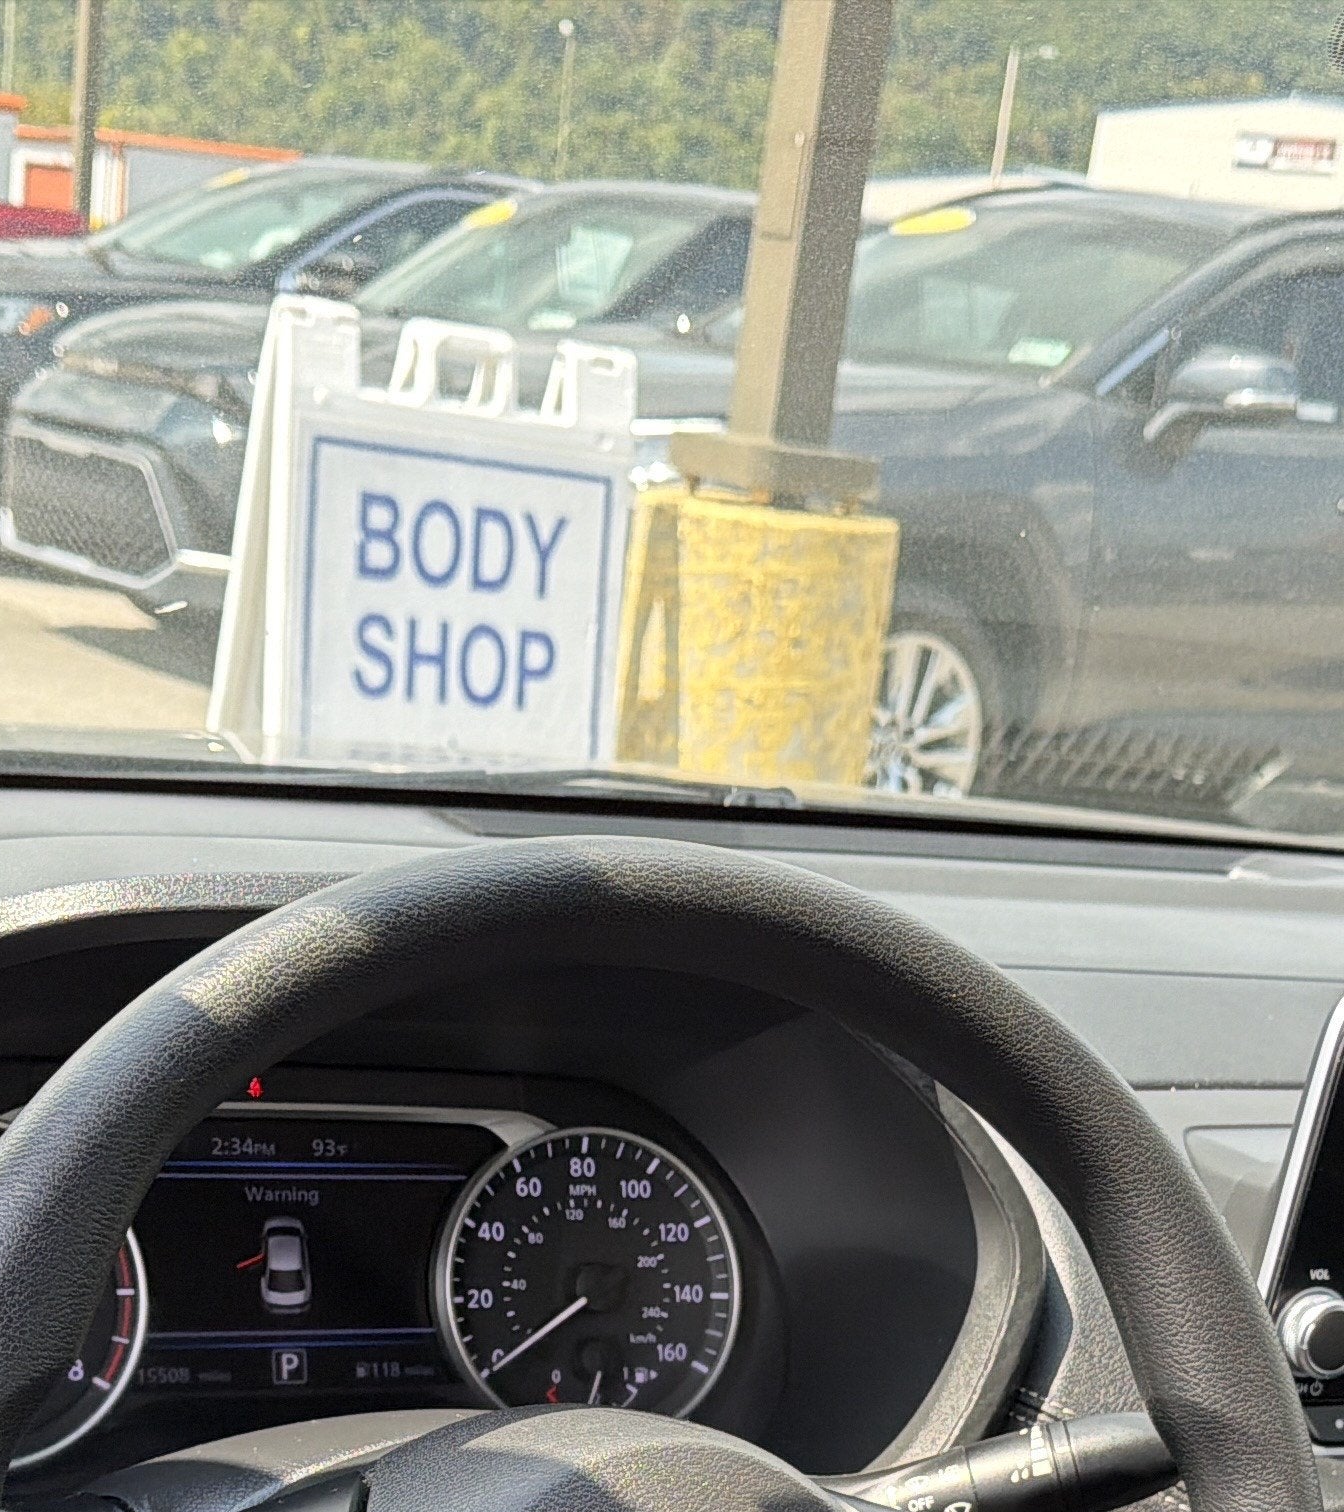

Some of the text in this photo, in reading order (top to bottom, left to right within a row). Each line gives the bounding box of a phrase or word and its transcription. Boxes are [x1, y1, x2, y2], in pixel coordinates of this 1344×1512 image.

[358, 490, 567, 599] BODY
[353, 613, 555, 710] SHOP
[569, 1156, 596, 1177] 80
[245, 1186, 319, 1206] Warning
[515, 1176, 542, 1197] 60
[568, 1184, 597, 1197] MPH
[619, 1178, 652, 1199] 100
[565, 1208, 584, 1221] 120
[477, 1221, 505, 1242] 40
[658, 1222, 689, 1243] 120
[1310, 1268, 1331, 1281] VOL
[467, 1288, 494, 1309] 20
[673, 1284, 704, 1304] 140
[657, 1342, 688, 1362] 160
[67, 1359, 85, 1382] 8
[281, 1352, 300, 1381] P
[907, 1495, 935, 1512] OFF
